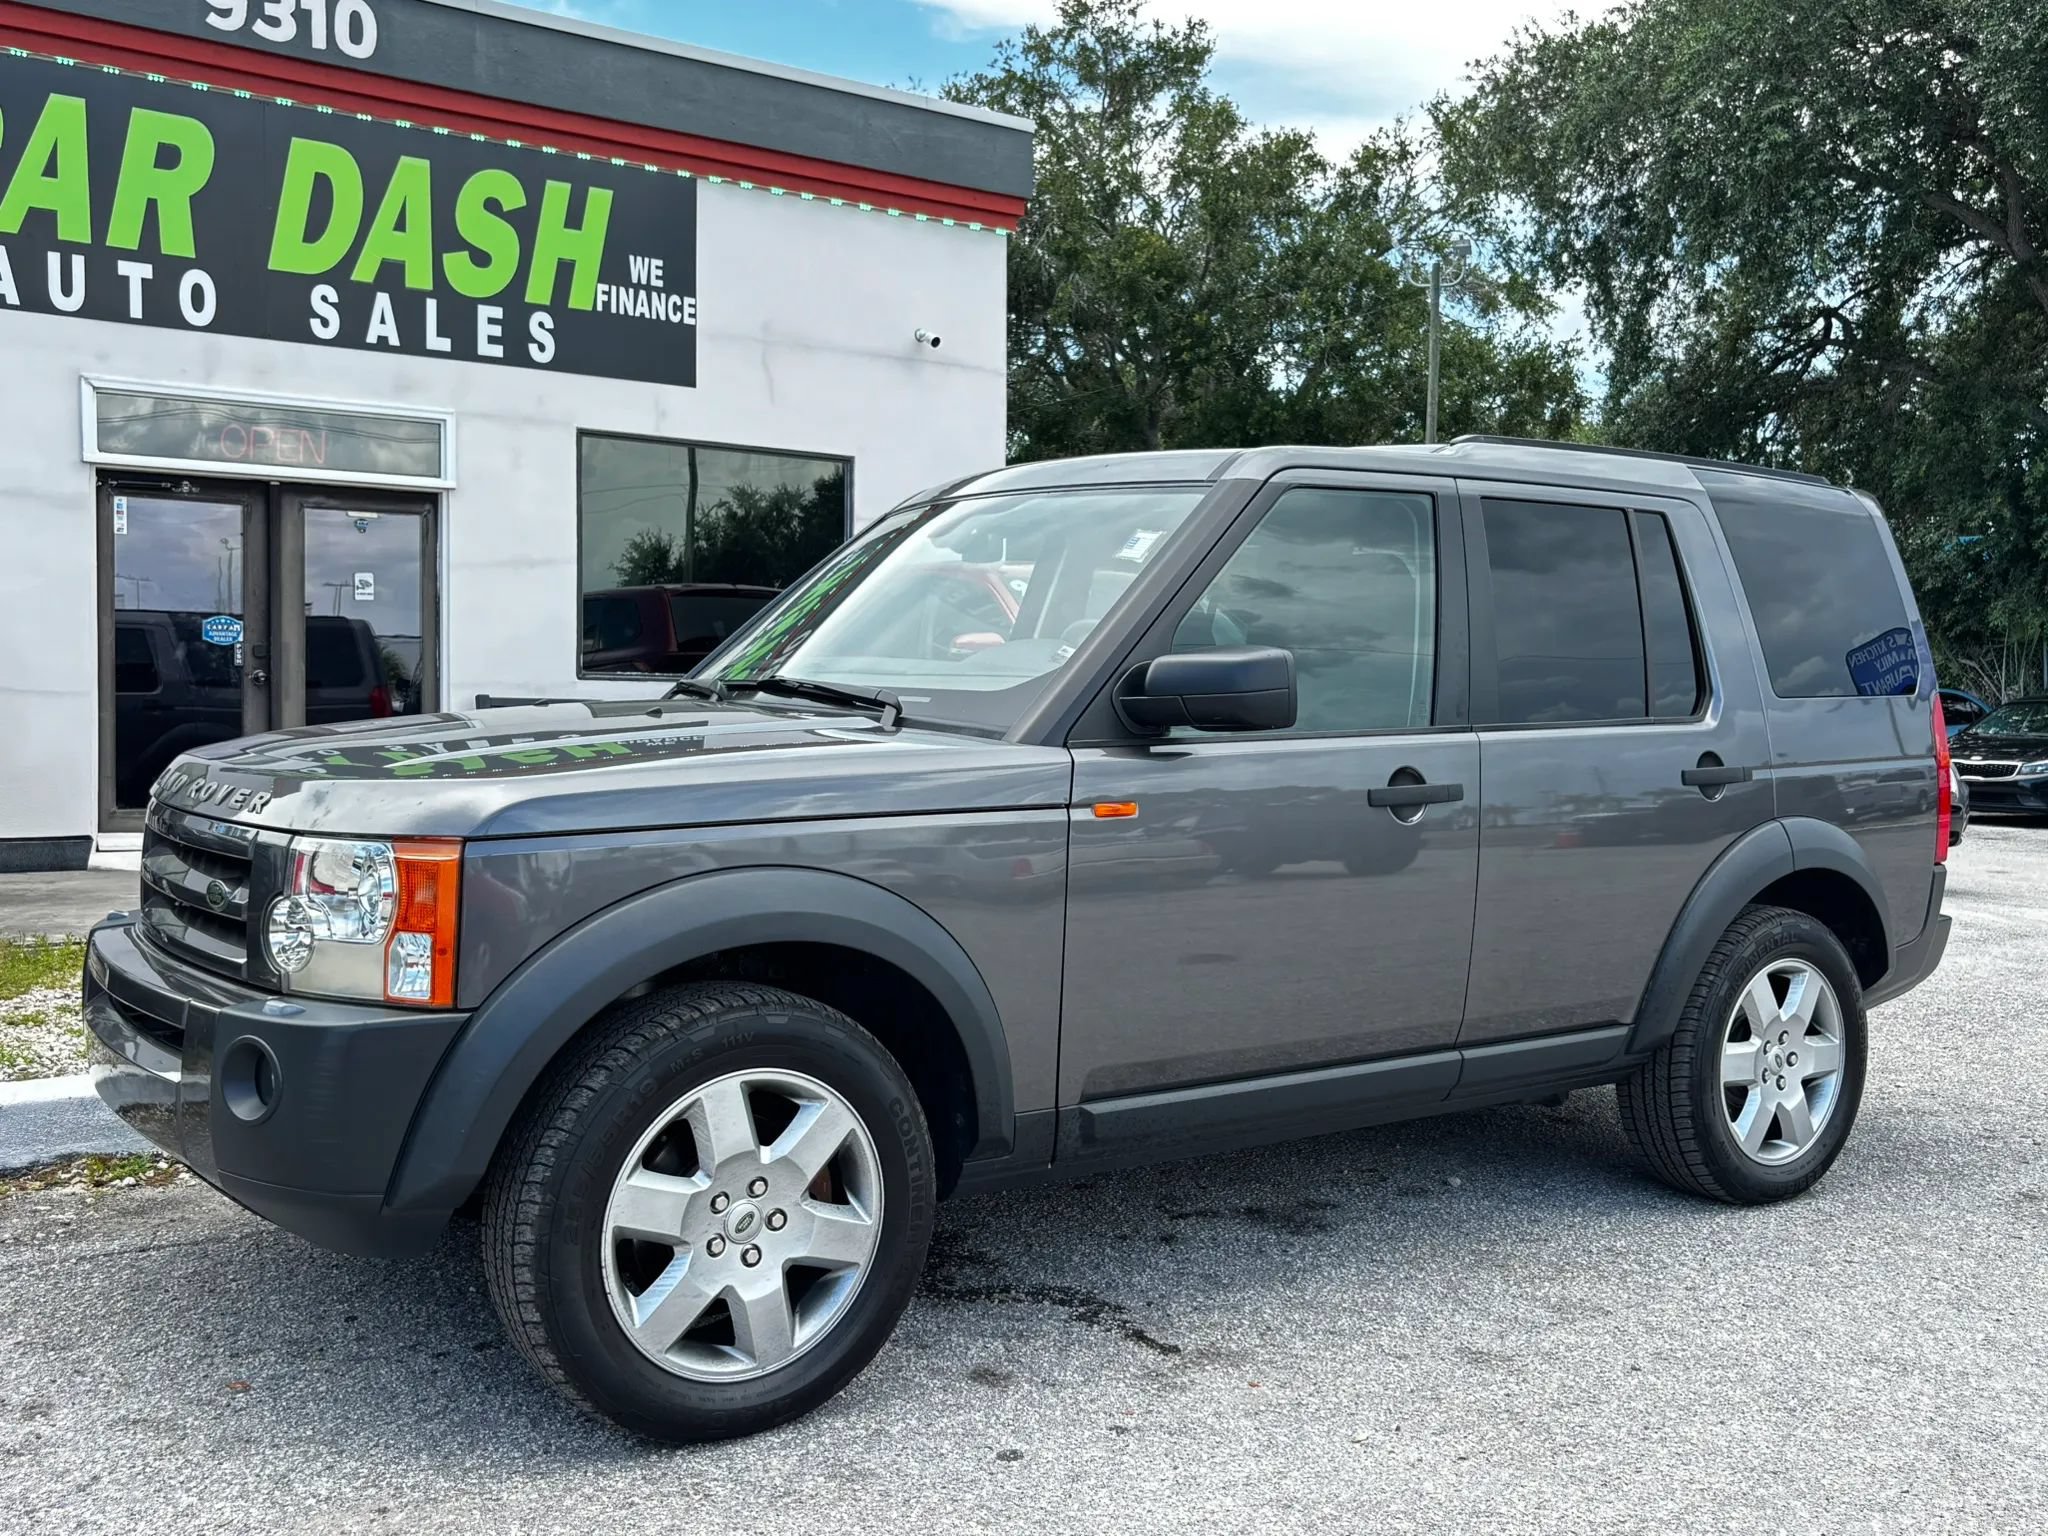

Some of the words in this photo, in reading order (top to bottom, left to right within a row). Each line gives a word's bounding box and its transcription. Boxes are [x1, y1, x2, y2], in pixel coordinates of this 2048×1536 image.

[0, 92, 216, 259] AR
[267, 136, 613, 311] DASH
[628, 254, 664, 287] WE
[309, 283, 557, 364] SALES
[596, 282, 696, 325] FINANCE
[220, 423, 328, 465] OPEN
[186, 778, 273, 815] ROVER
